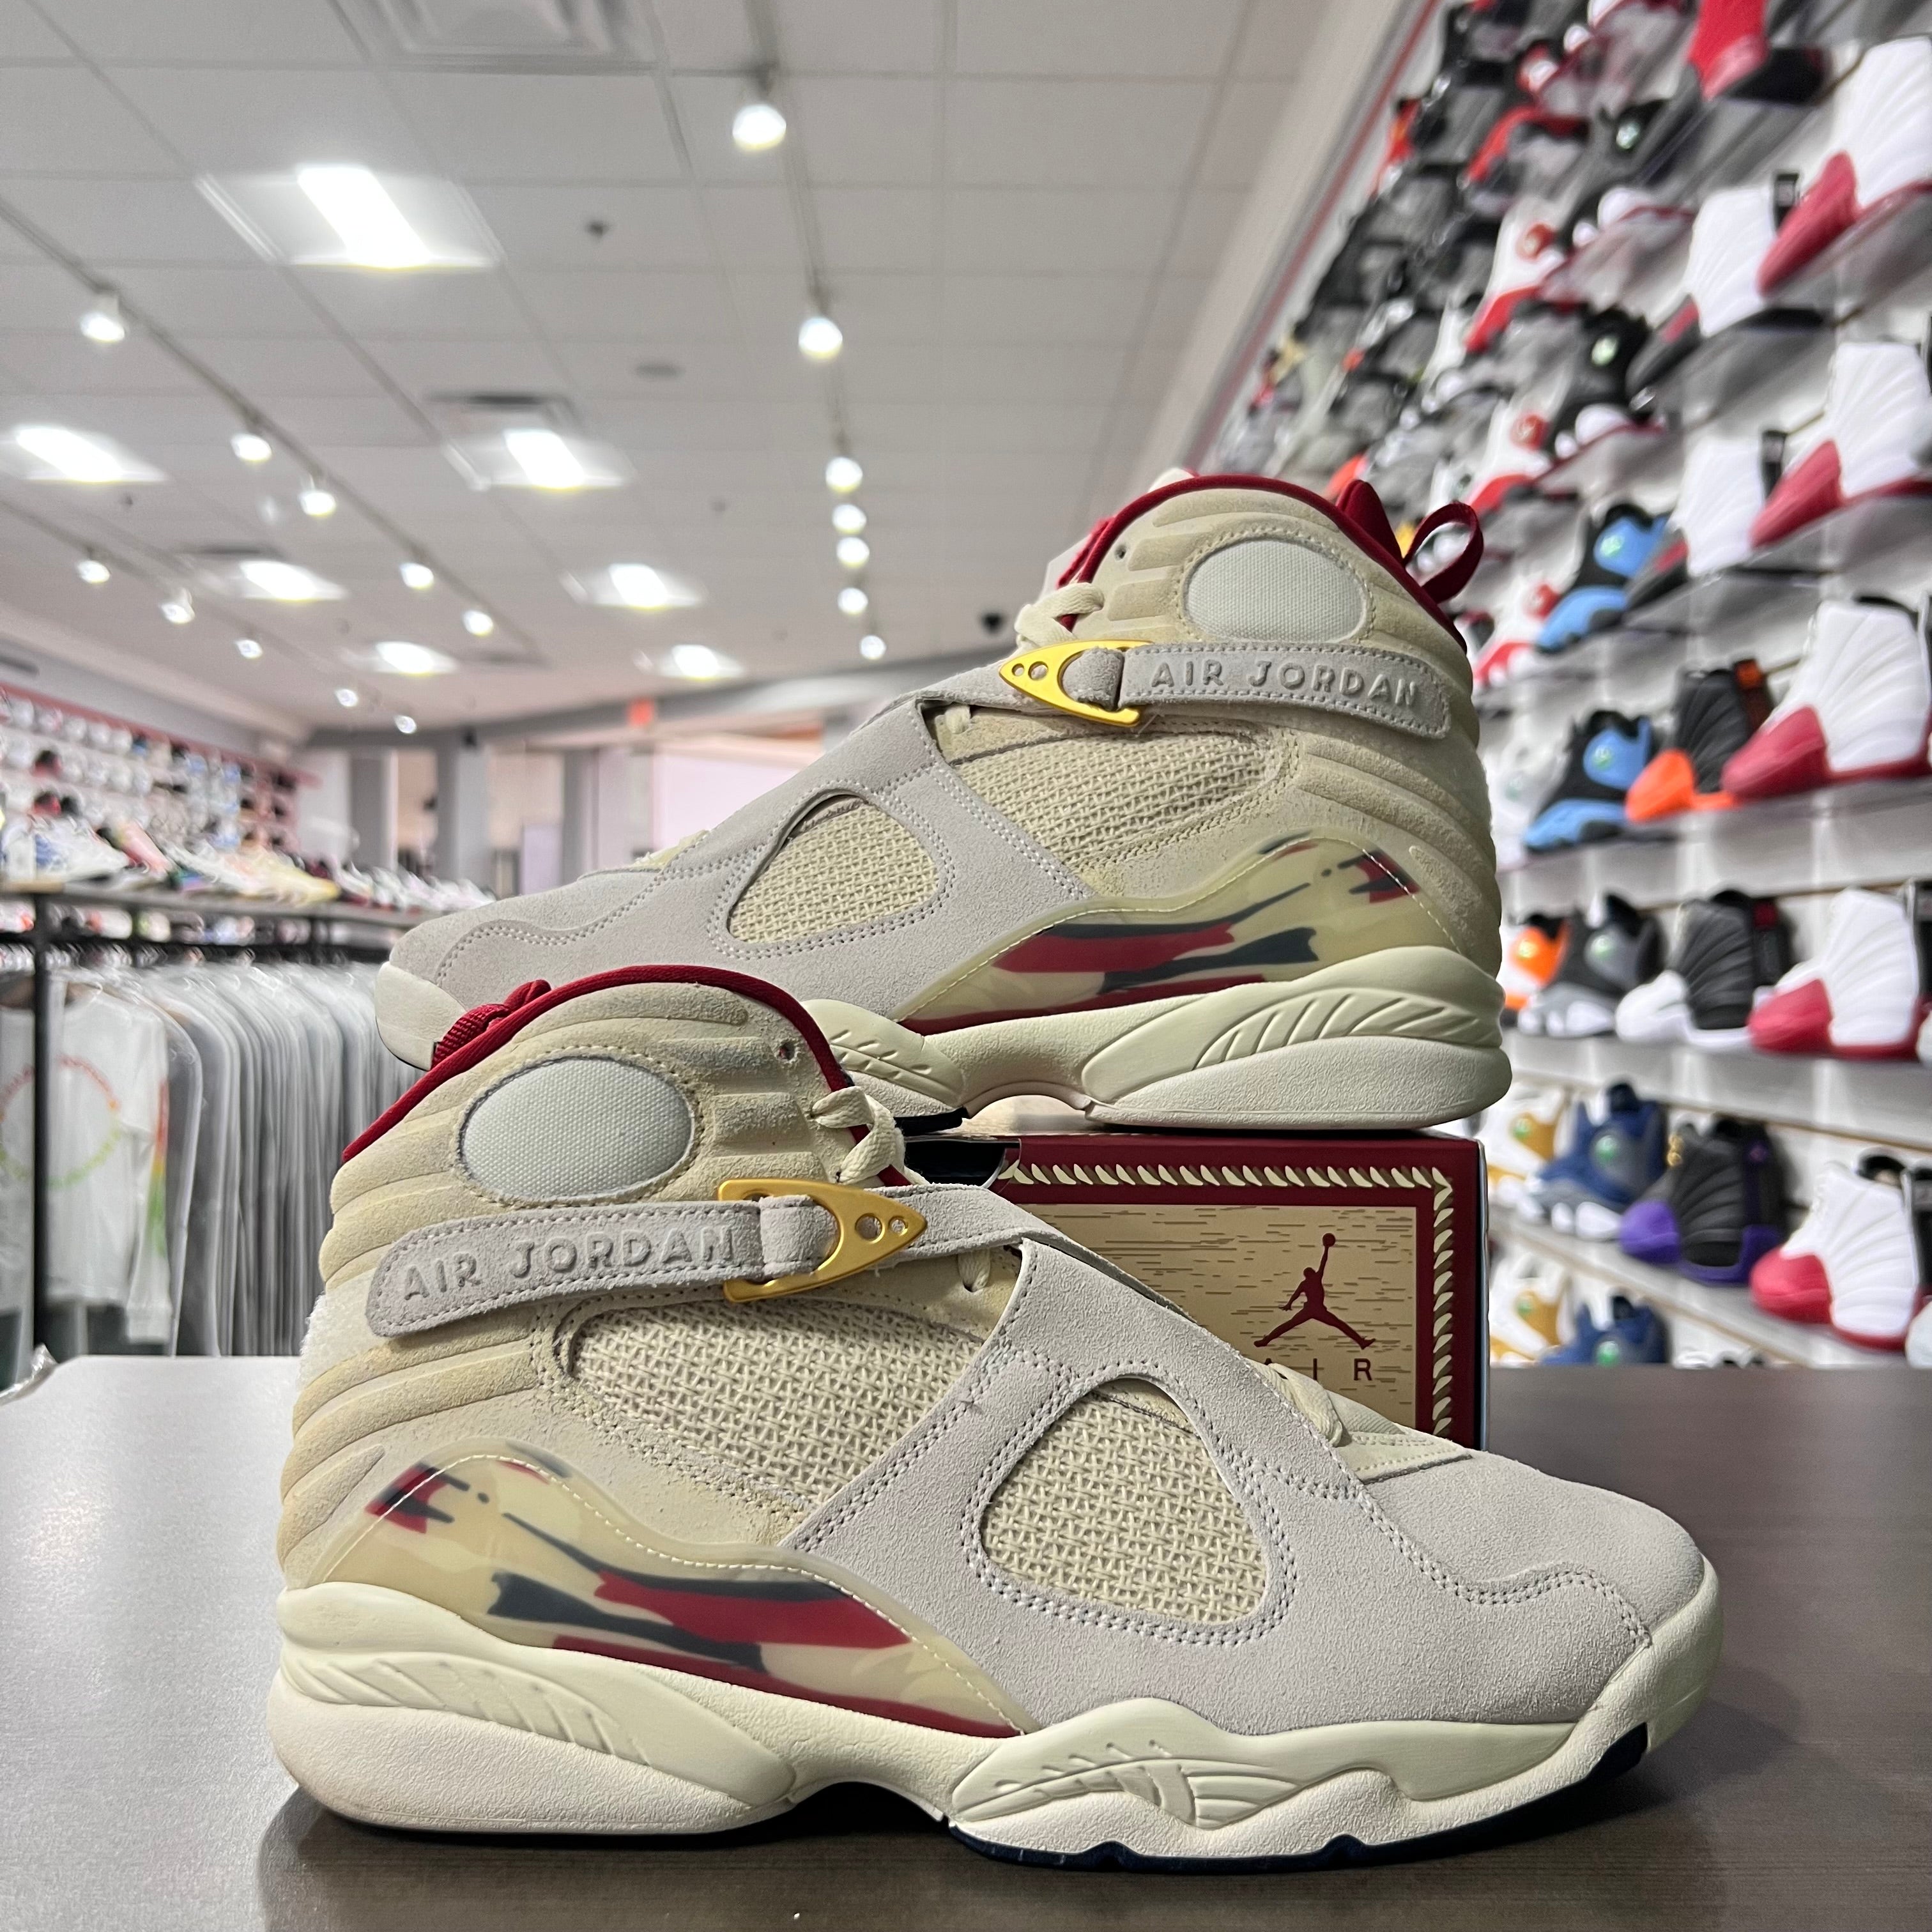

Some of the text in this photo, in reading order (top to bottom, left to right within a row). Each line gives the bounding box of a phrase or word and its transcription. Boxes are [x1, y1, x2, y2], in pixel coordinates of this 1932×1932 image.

[1151, 659, 1416, 706] AIR JORDAN
[404, 1227, 734, 1301] AIR JORDAN
[1262, 1358, 1372, 1381] IR
